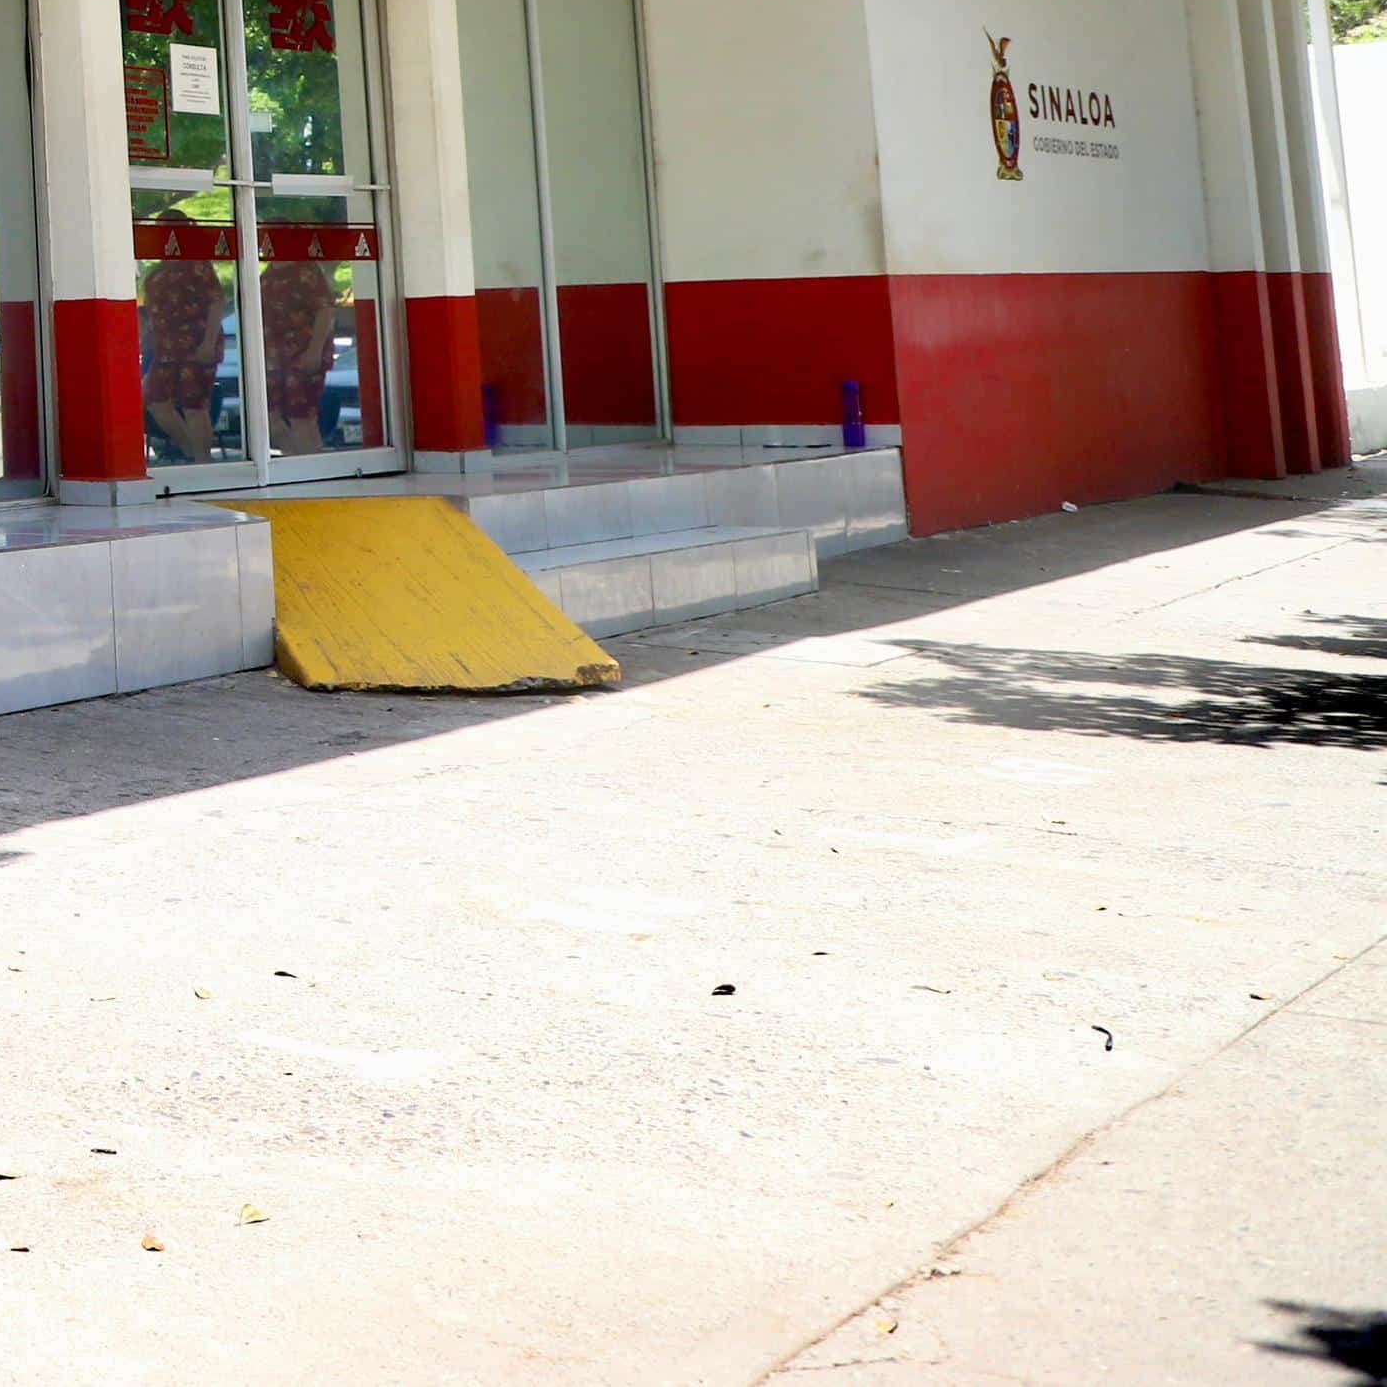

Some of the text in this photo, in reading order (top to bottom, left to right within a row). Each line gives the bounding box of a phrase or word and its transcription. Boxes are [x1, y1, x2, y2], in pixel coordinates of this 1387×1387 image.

[1028, 83, 1116, 129] SINALOA
[1033, 136, 1120, 159] GOBIERNO DEL ESTADO
